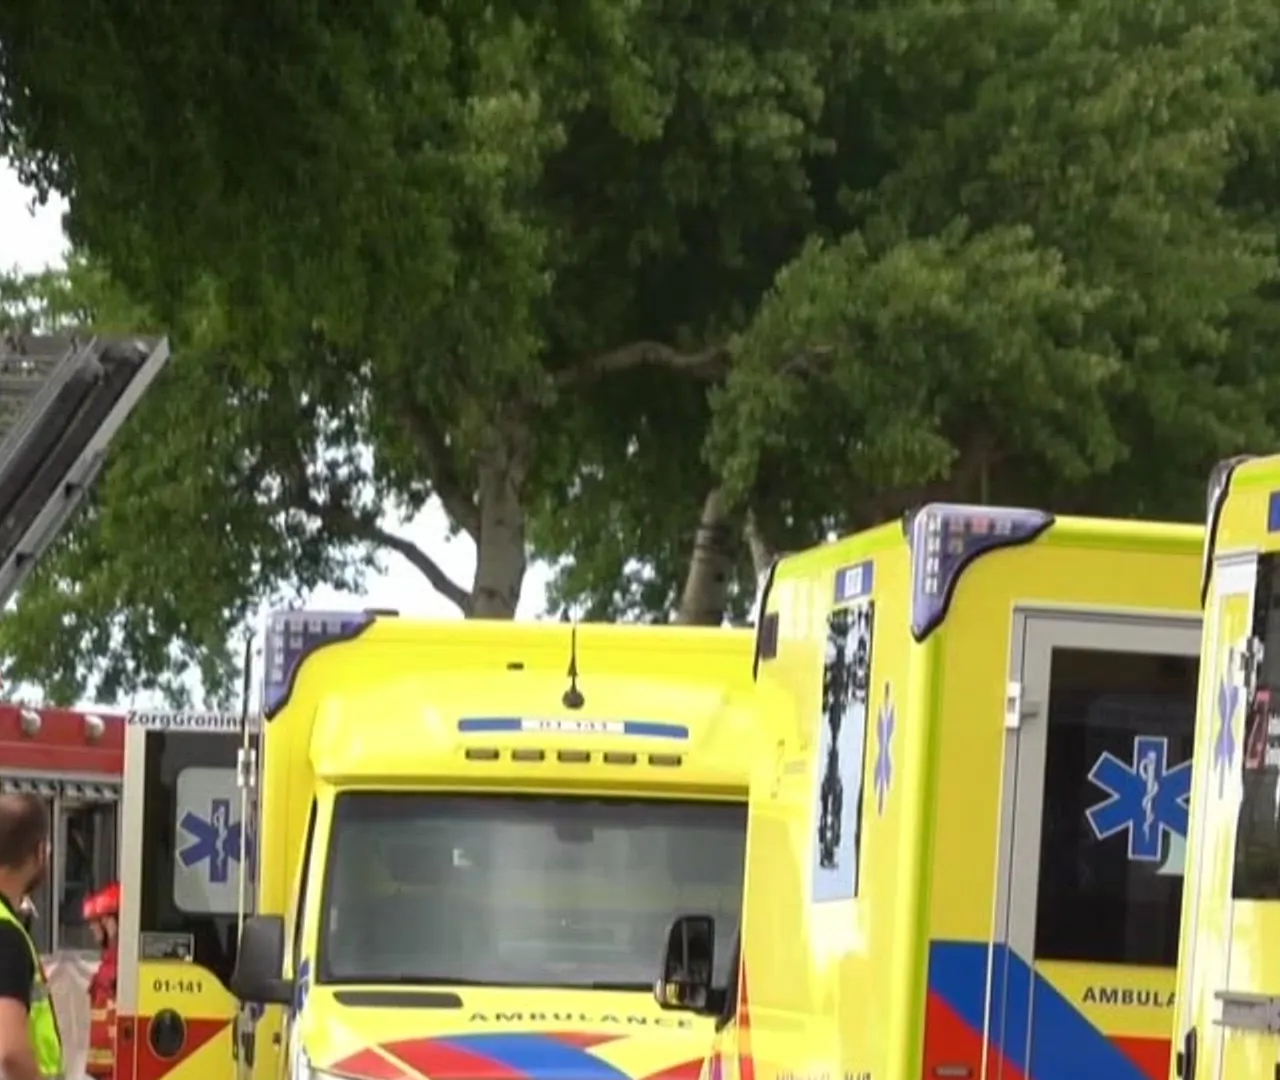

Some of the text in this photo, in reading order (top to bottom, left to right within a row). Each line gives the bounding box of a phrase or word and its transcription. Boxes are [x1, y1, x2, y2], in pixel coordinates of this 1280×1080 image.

[127, 710, 245, 728] ZorgGronin
[153, 979, 202, 993] 01-141
[1082, 987, 1175, 1008] AMBULA
[469, 1012, 693, 1028] AMBULANCE
